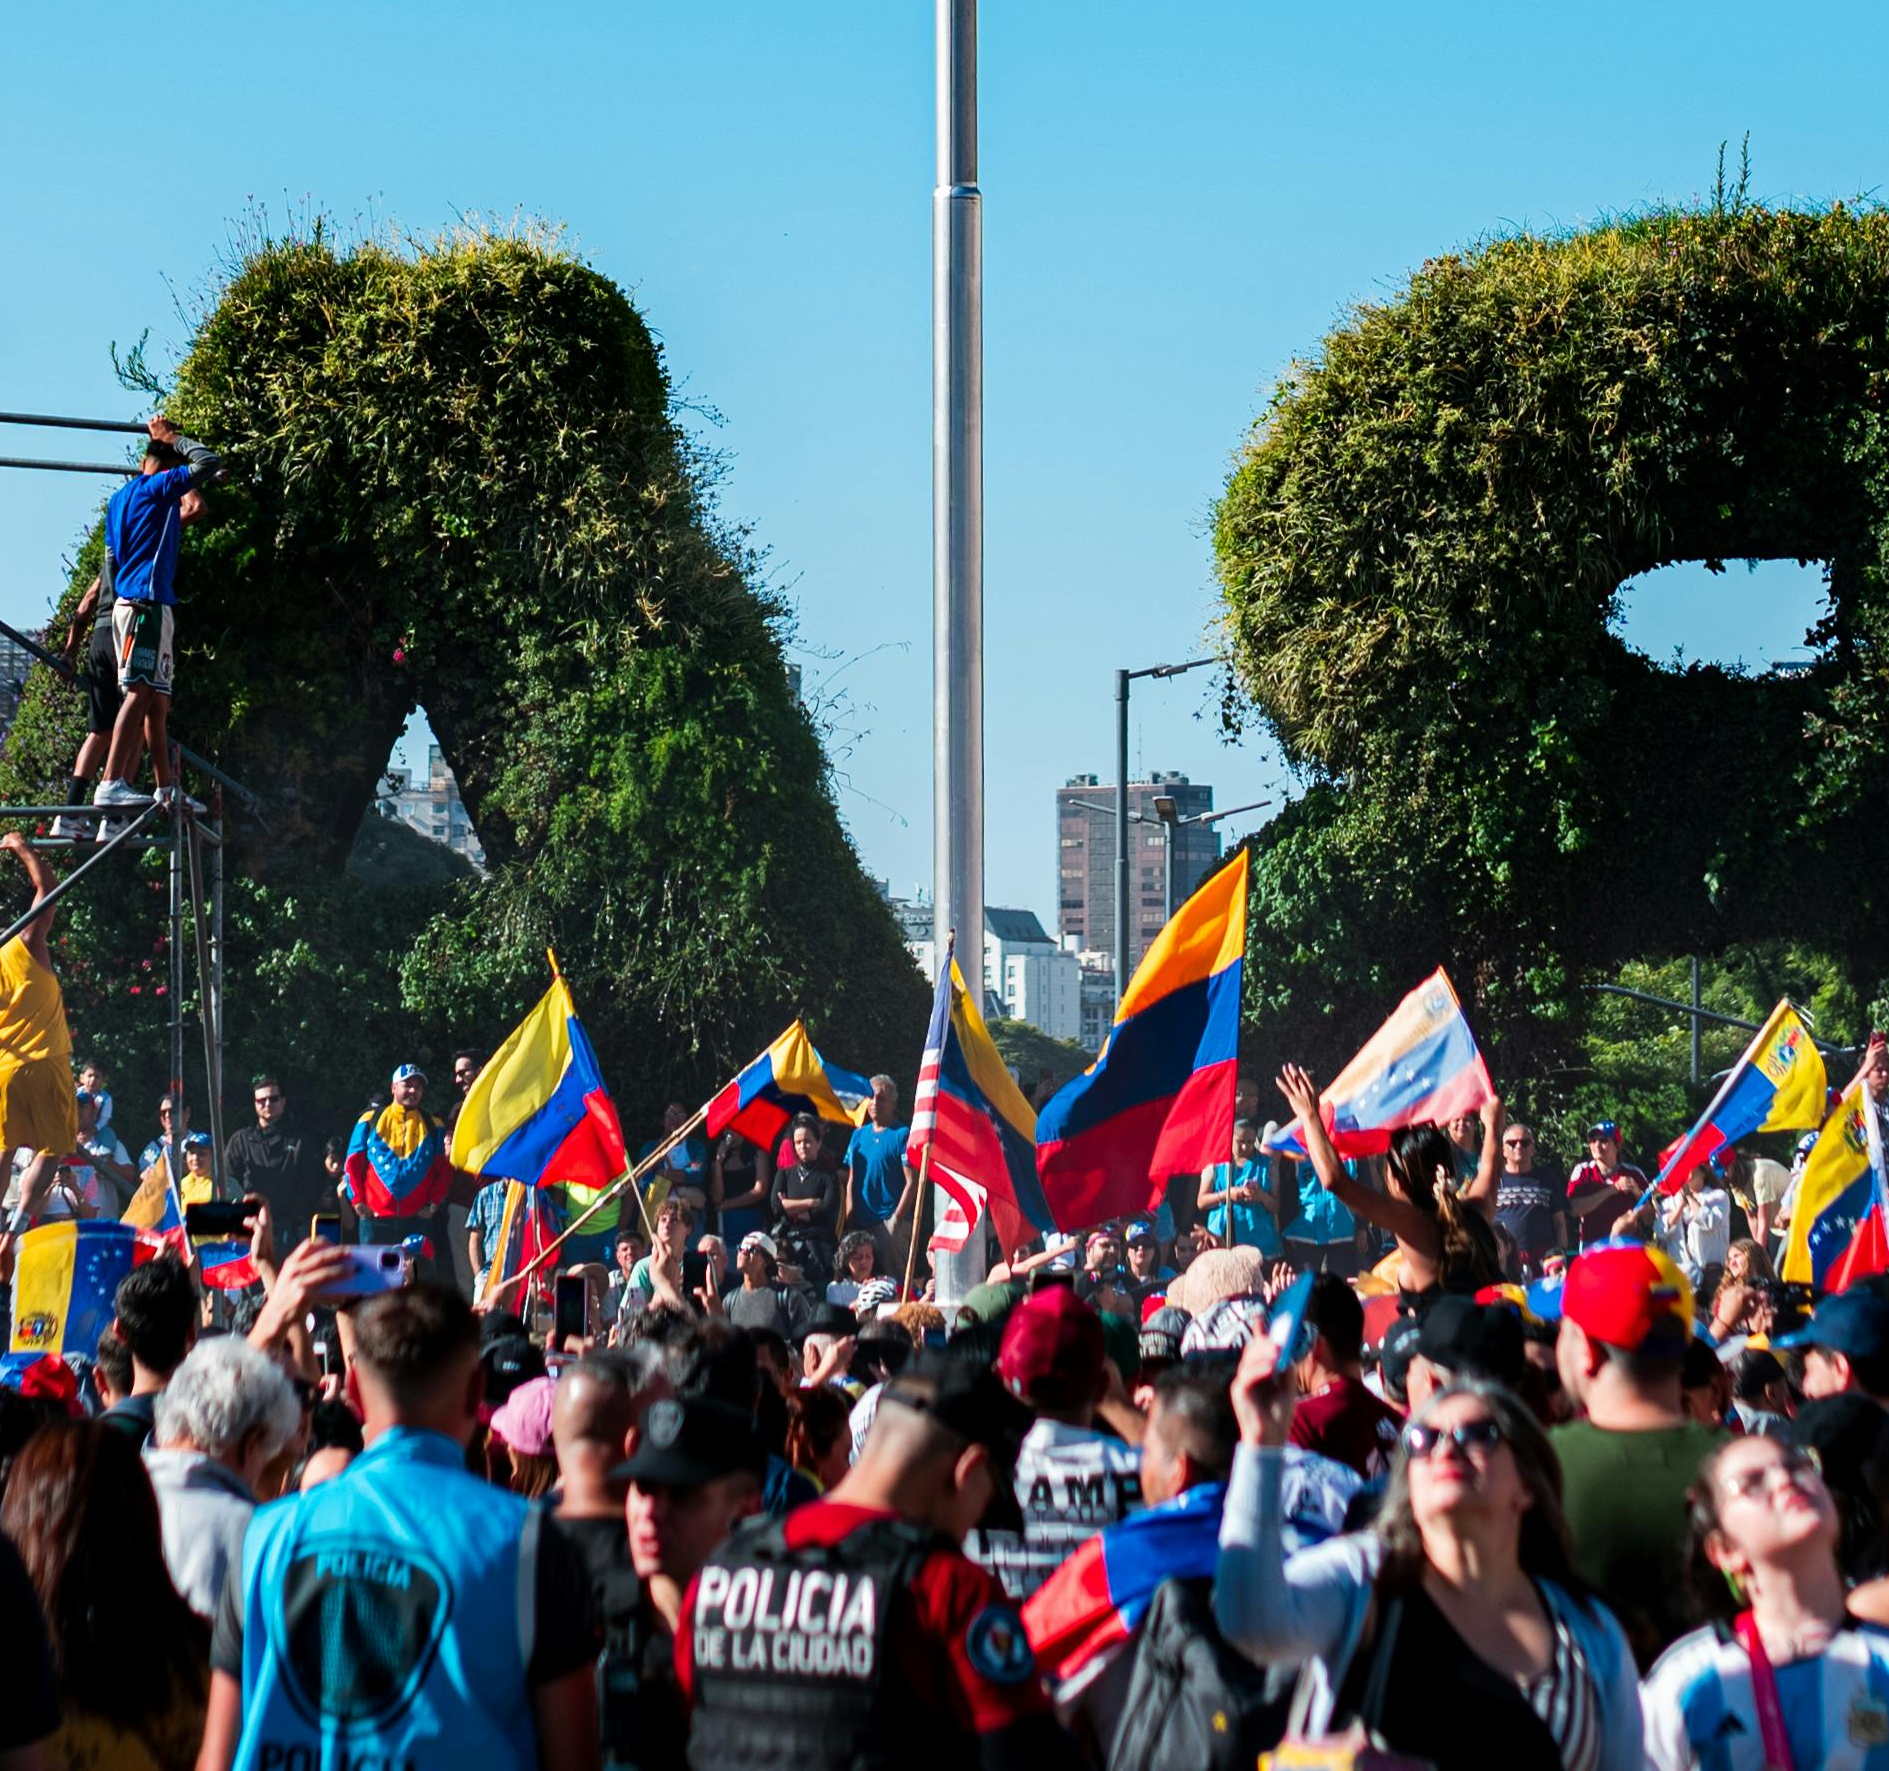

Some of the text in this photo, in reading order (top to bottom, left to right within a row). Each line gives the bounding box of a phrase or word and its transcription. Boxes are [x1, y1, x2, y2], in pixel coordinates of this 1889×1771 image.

[316, 1550, 412, 1591] POLICIA
[694, 1565, 876, 1638] POLICIA
[694, 1627, 875, 1679] DE LA CIUDAD
